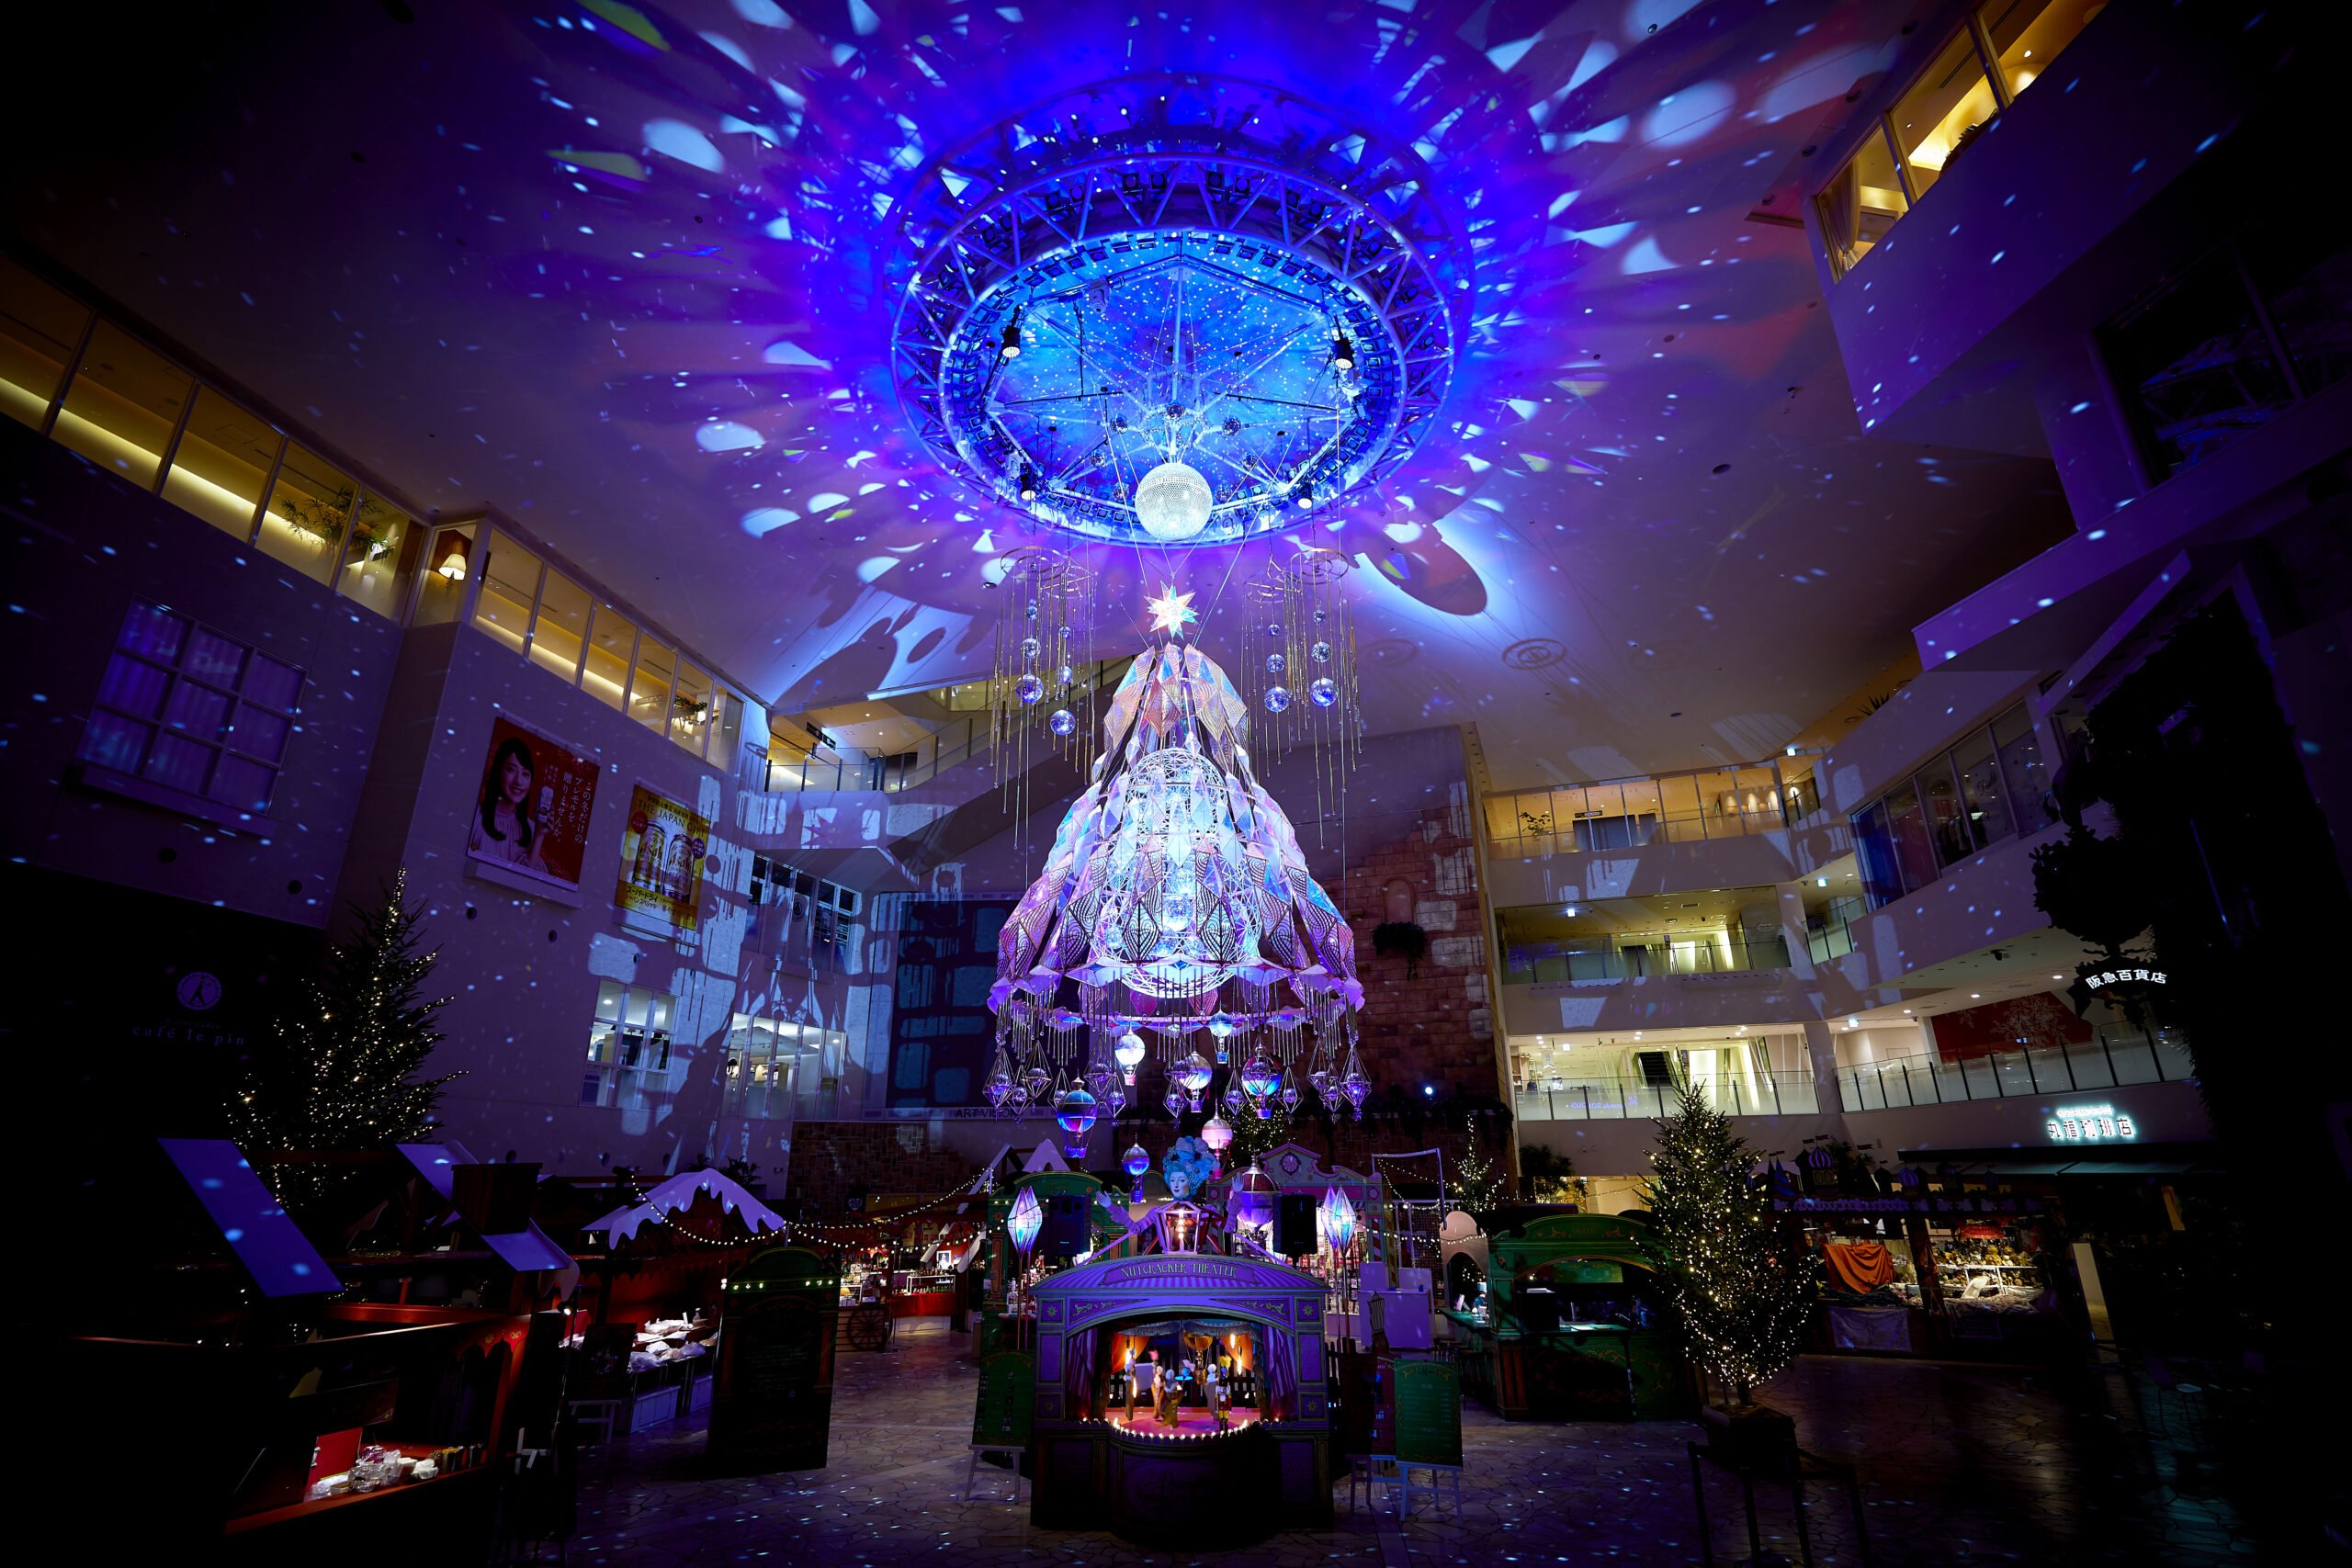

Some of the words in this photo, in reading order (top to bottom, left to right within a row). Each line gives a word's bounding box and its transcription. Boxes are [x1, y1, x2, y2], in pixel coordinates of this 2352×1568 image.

[574, 780, 591, 843] この冬だけの
[638, 798, 654, 815] THE
[657, 809, 684, 828] JAPAN
[686, 821, 706, 838] GIFT
[626, 886, 659, 902] スーパードライ
[2086, 969, 2167, 989] 阪急百貨店
[187, 1028, 204, 1041] le
[214, 1033, 244, 1046] pin
[956, 1108, 978, 1118] ART
[2047, 1118, 2132, 1138] 丸福珈琲店
[1121, 1263, 1187, 1278] NUTCRACKER
[1193, 1263, 1237, 1278] THEATER
